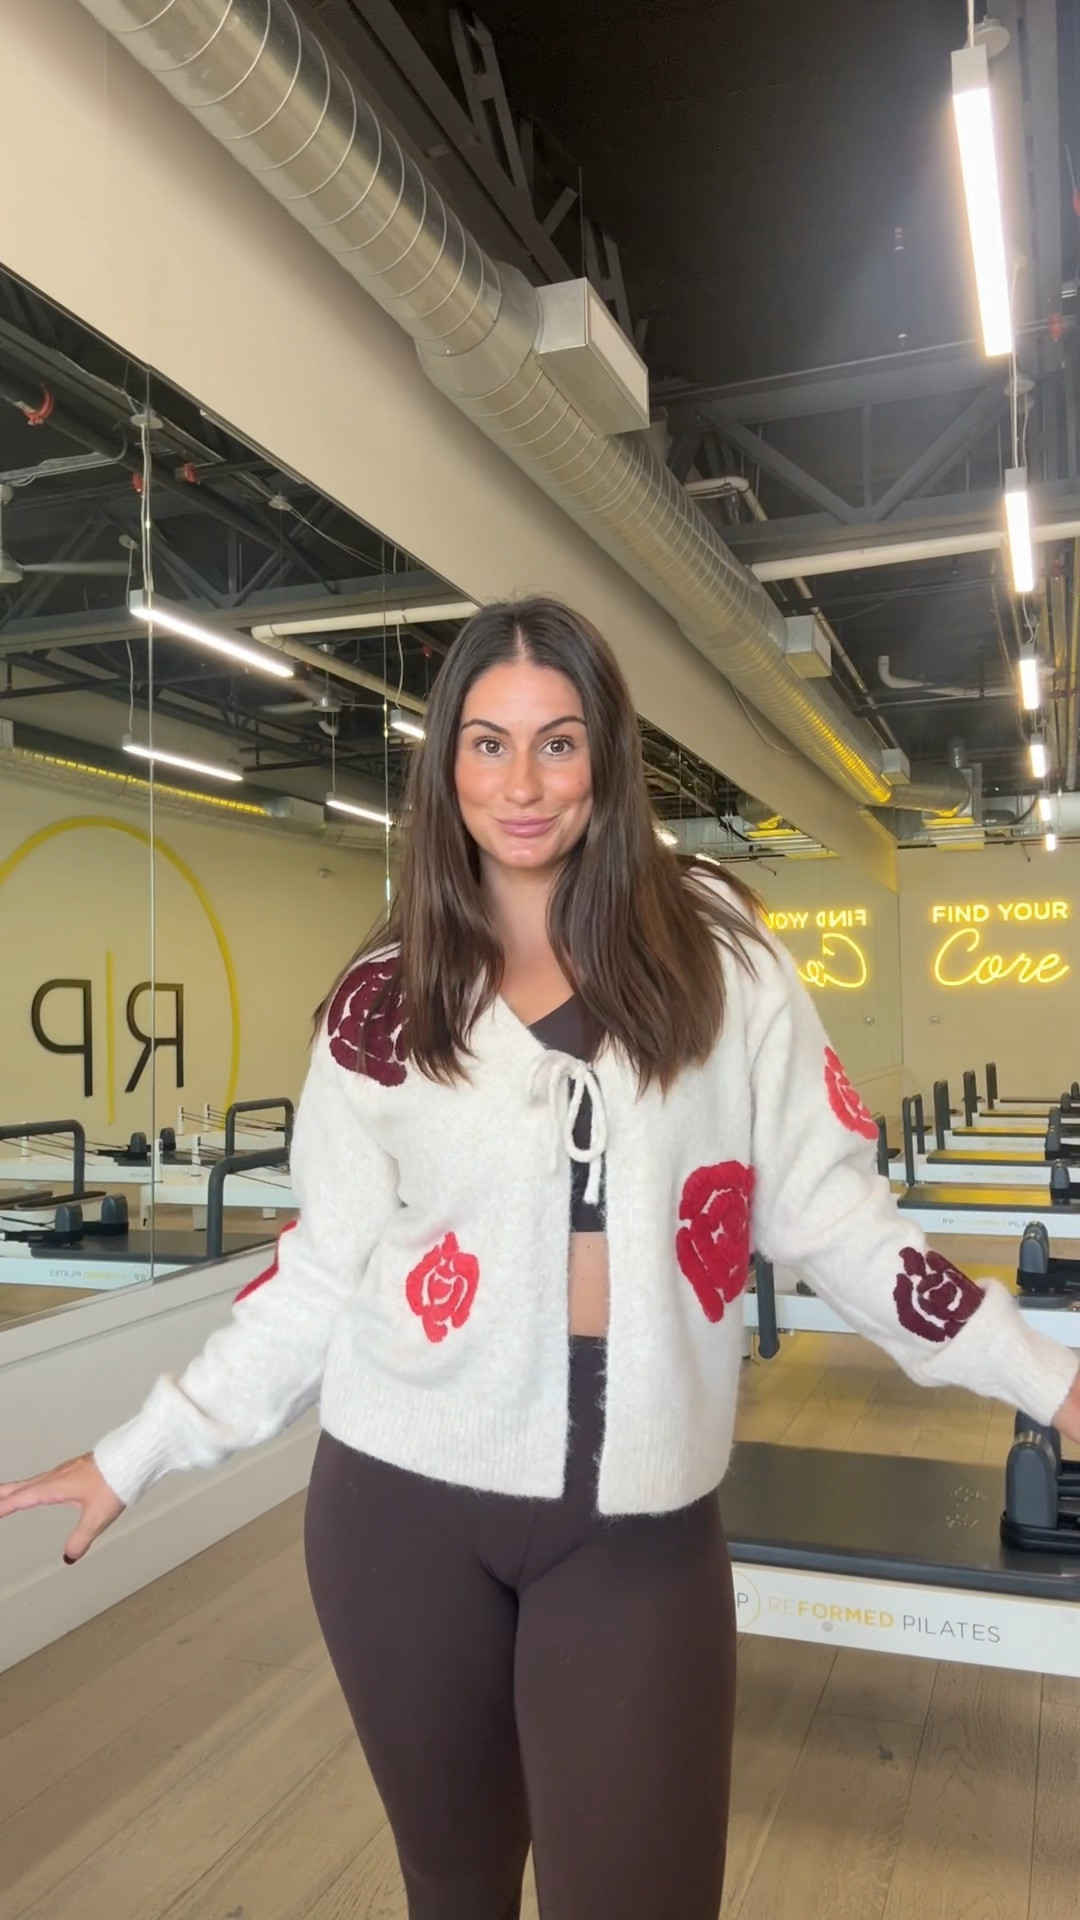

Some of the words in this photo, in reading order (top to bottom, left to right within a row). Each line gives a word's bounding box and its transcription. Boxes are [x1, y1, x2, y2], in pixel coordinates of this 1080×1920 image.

[932, 904, 990, 924] FIND
[998, 901, 1068, 921] YOUR
[934, 928, 1070, 986] Core
[737, 1593, 749, 1609] P
[768, 1595, 894, 1628] REFORMED
[903, 1615, 1001, 1643] PILATES
